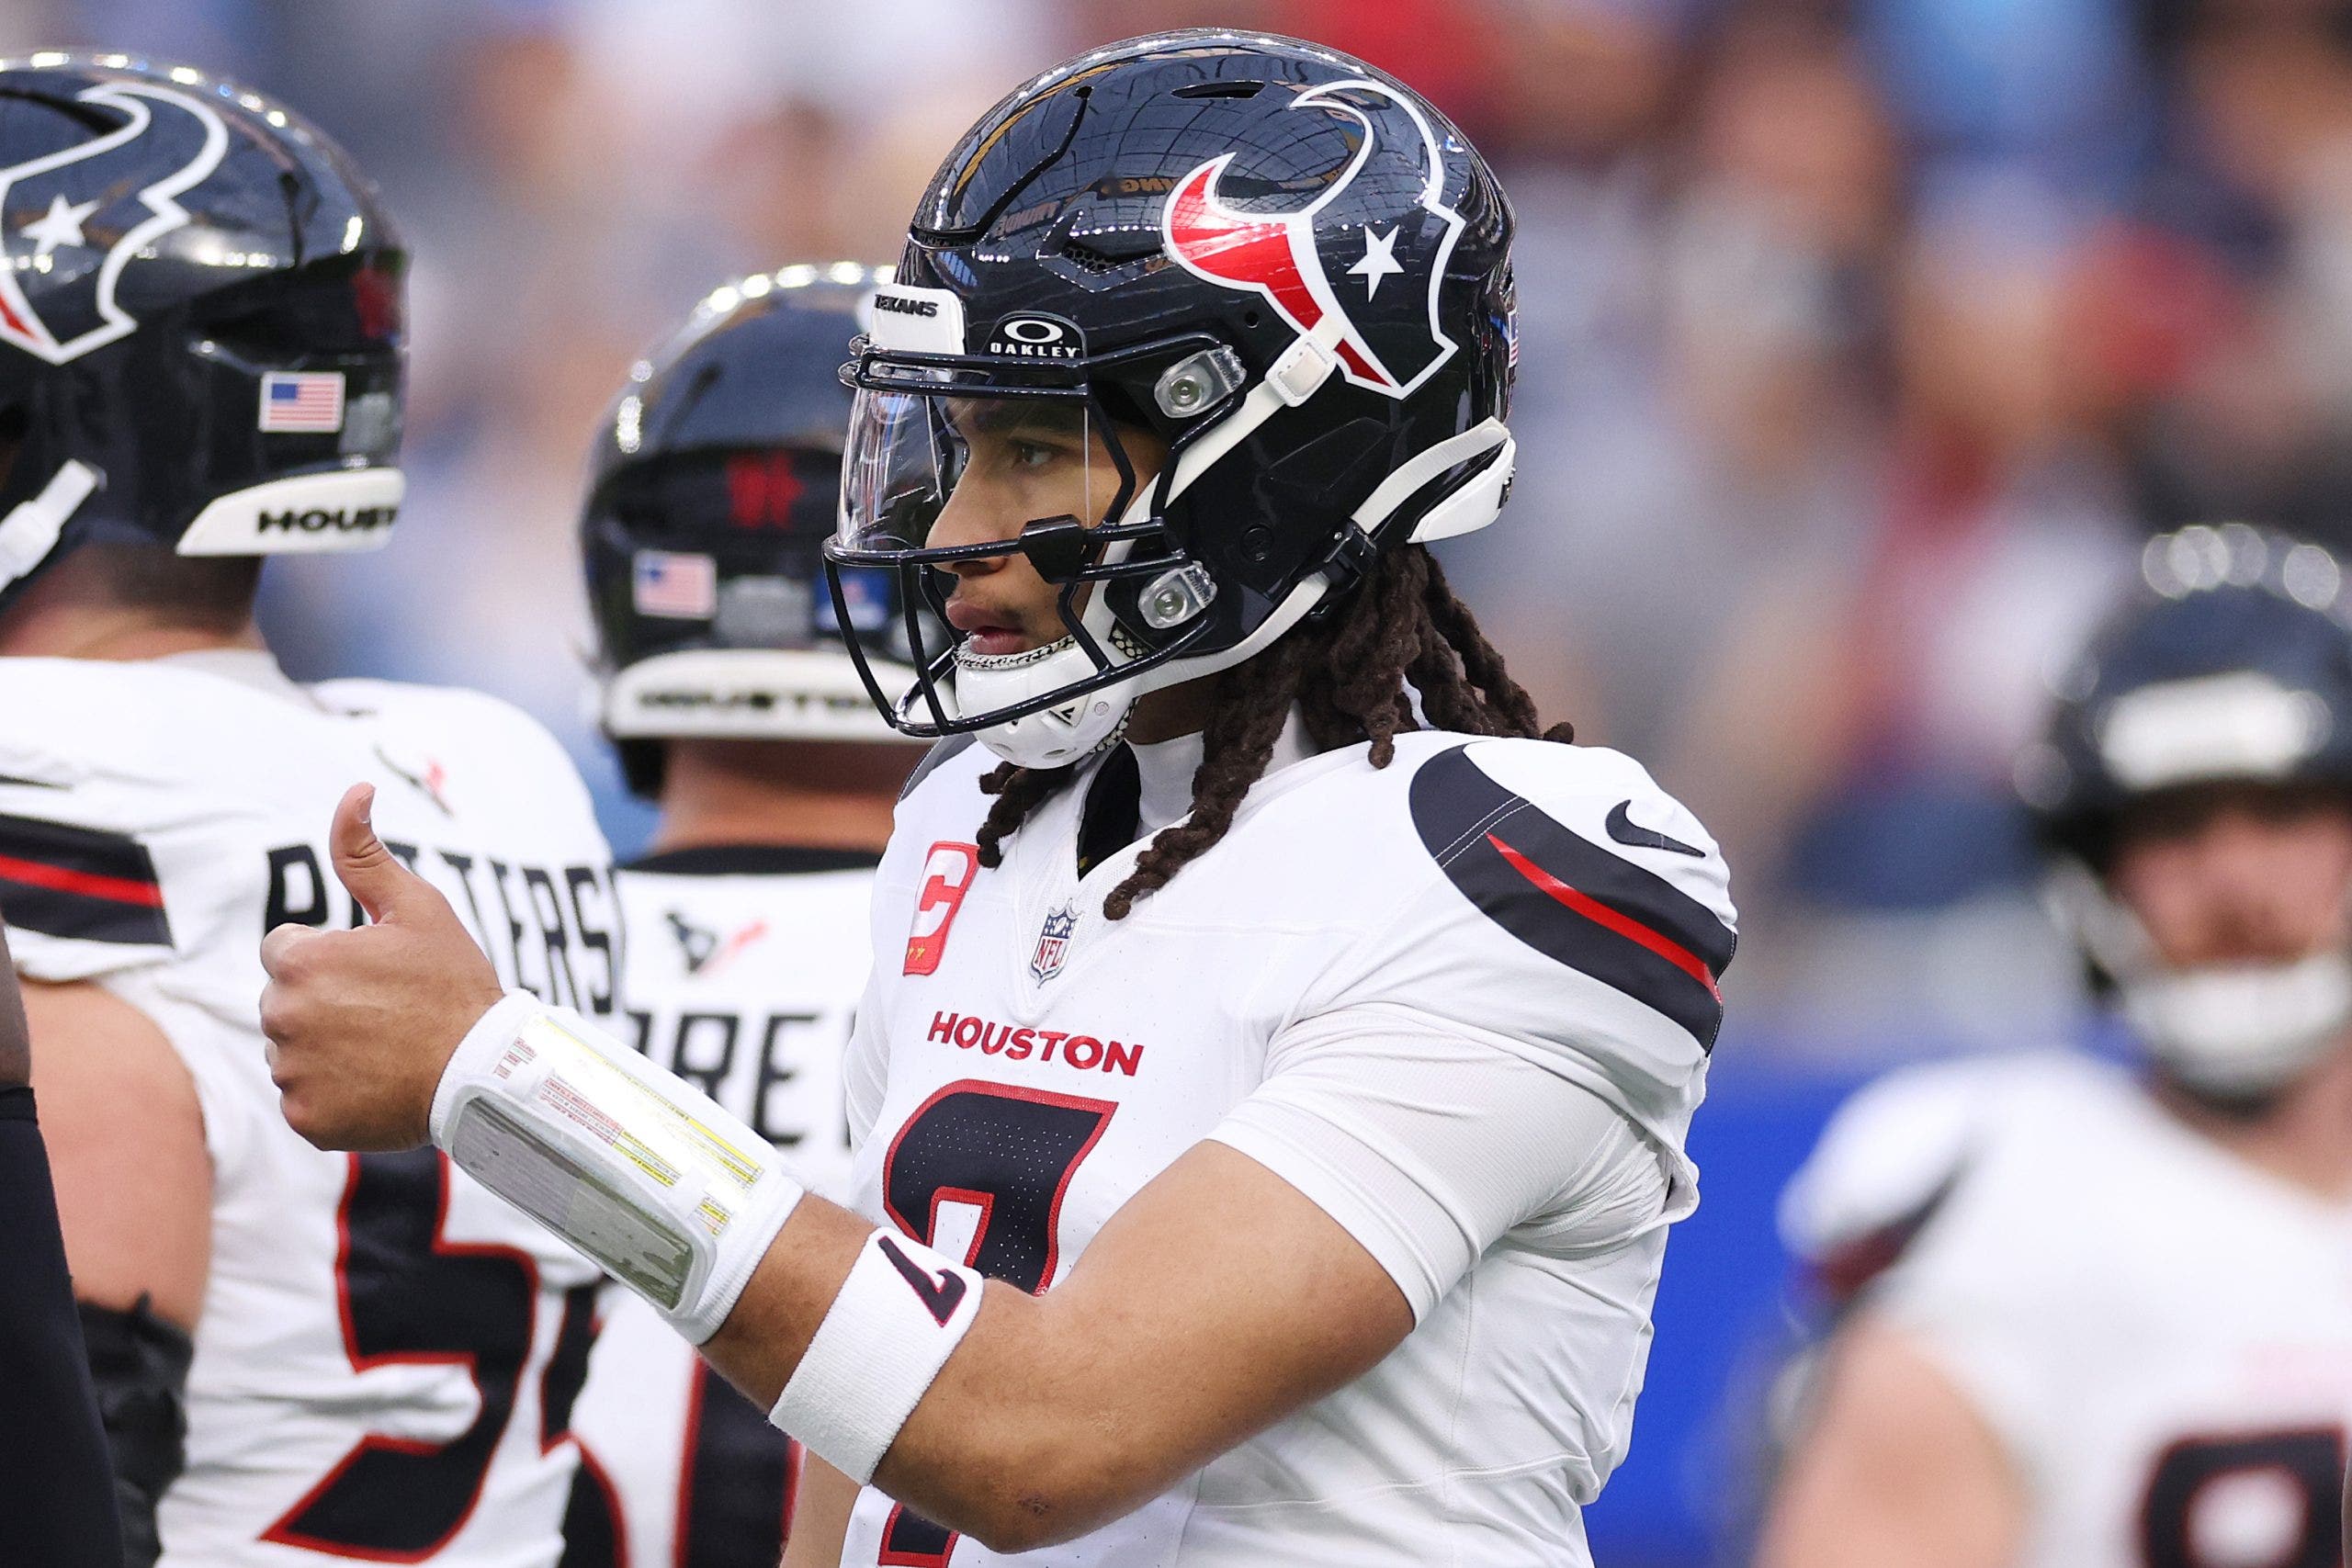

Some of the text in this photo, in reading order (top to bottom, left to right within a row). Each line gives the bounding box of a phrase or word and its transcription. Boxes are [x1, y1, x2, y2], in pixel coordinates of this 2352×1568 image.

[875, 294, 938, 318] TEXANS
[990, 343, 1077, 357] OAKLEY
[1035, 937, 1064, 970] NFL
[927, 1011, 1144, 1077] HOUSTON
